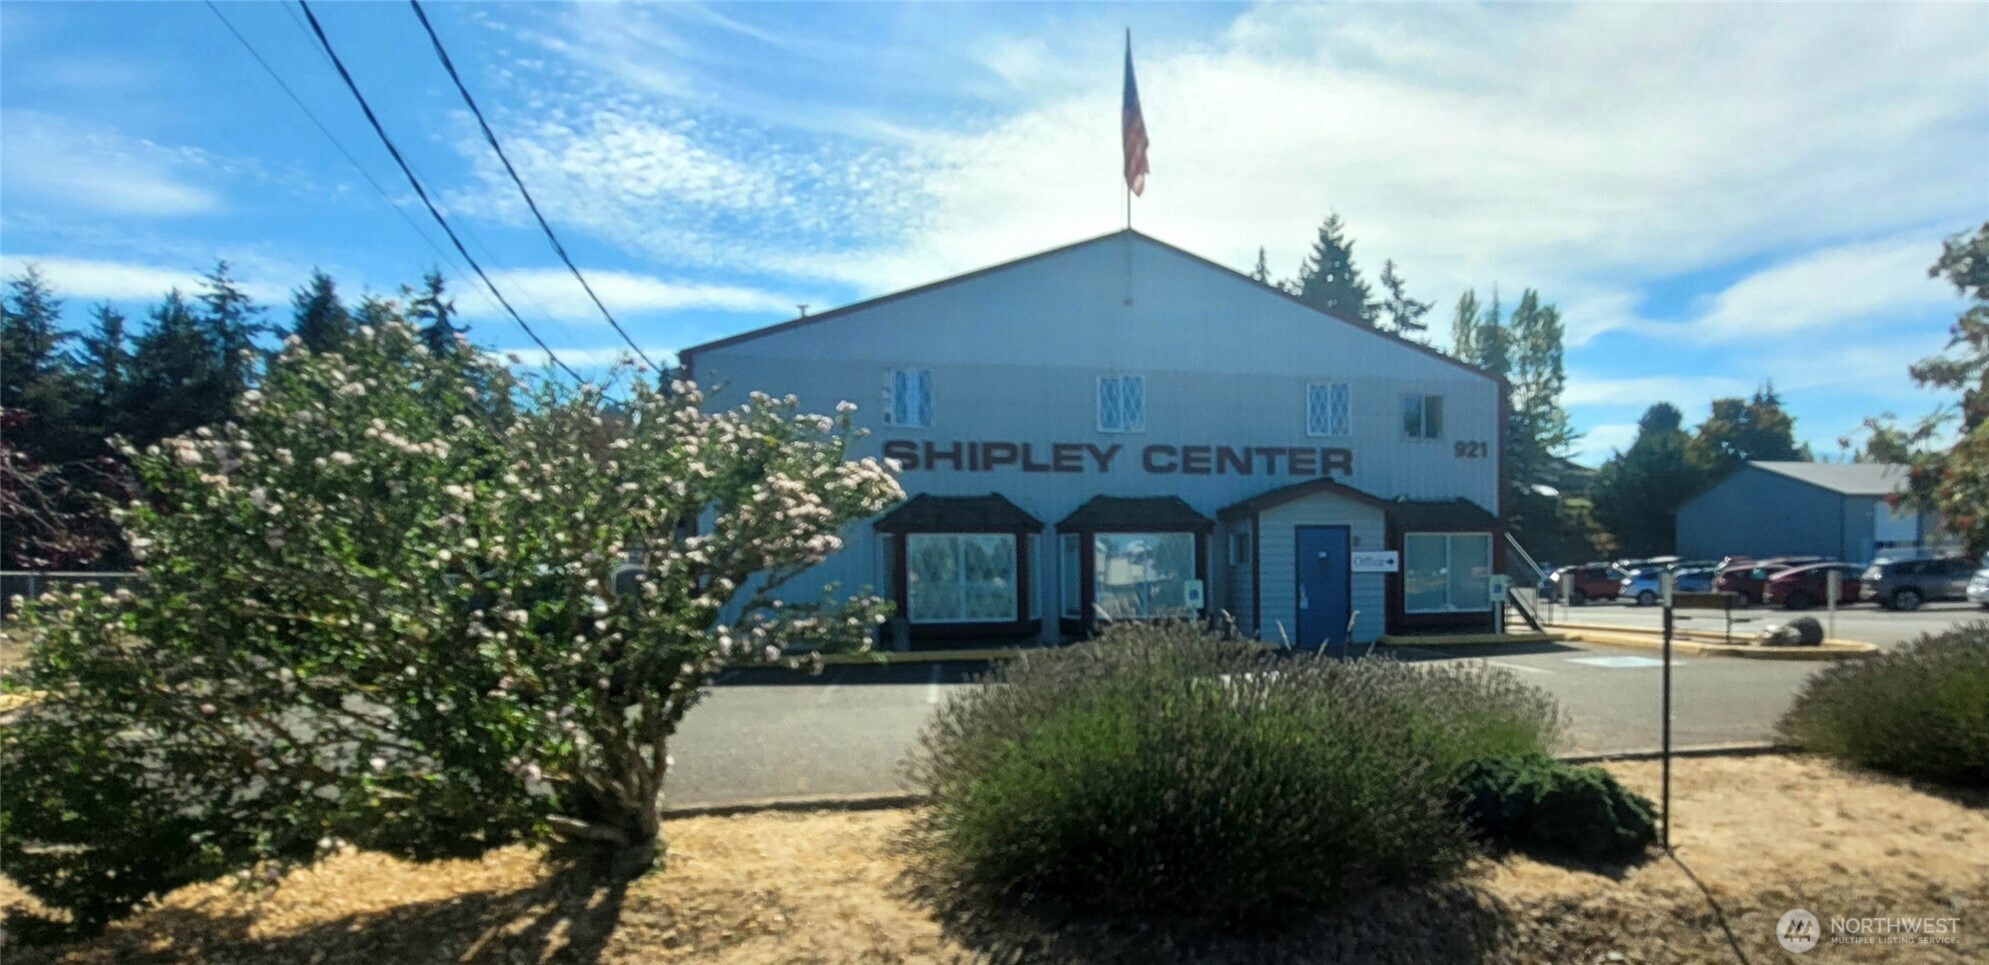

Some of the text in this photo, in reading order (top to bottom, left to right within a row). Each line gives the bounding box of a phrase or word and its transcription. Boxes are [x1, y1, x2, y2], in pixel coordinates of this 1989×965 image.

[884, 440, 1353, 476] SHIPLEY CENTER
[1454, 440, 1488, 459] 921
[1353, 556, 1384, 567] Office
